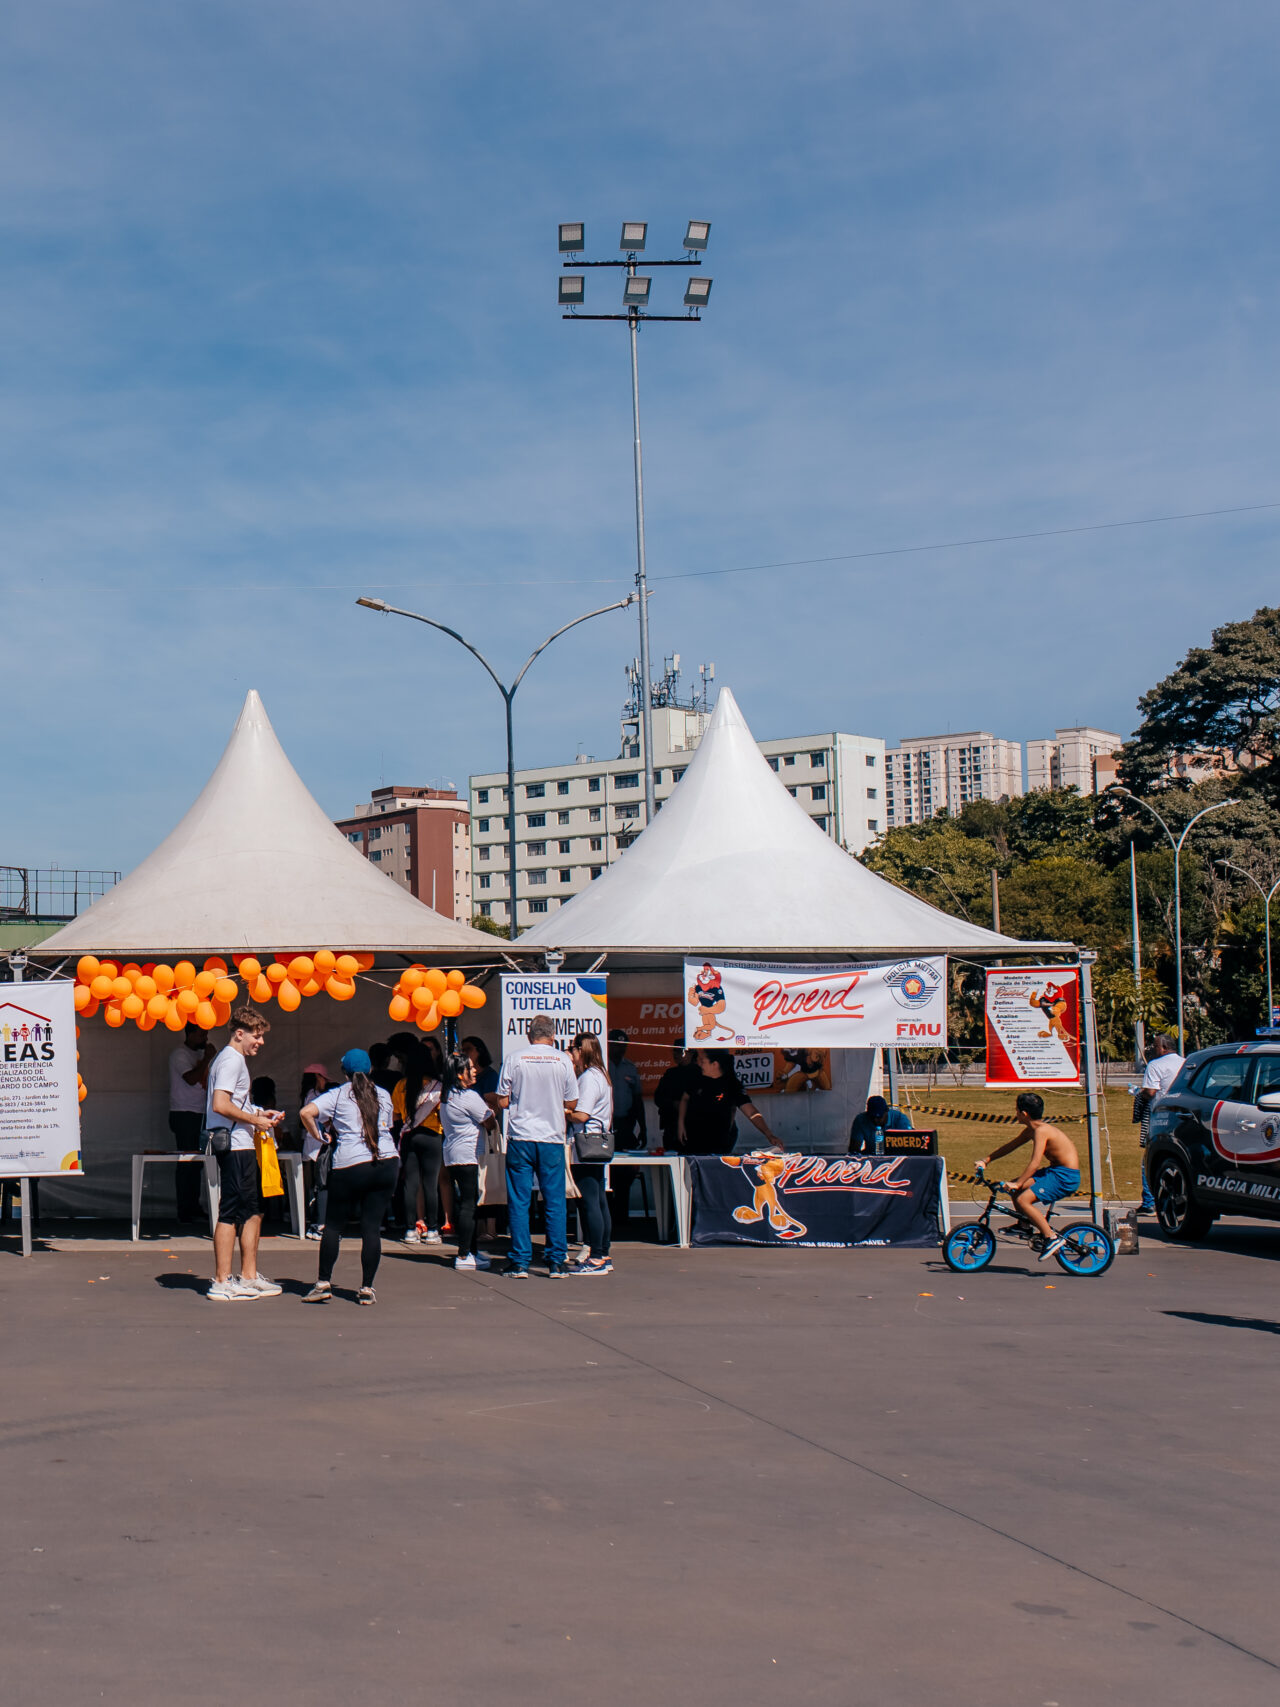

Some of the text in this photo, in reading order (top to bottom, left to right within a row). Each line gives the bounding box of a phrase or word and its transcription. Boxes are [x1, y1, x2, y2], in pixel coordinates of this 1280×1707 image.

[723, 961, 767, 969] Ensinando
[913, 961, 939, 981] MILITAR
[506, 981, 576, 995] CONSELHO
[510, 997, 572, 1010] TUTELAR
[753, 975, 864, 1025] Proerd
[639, 1003, 684, 1019] PRO
[507, 1017, 603, 1036] ATEIMENTO
[642, 1027, 665, 1035] uma
[669, 1025, 684, 1034] vid
[896, 1023, 941, 1036] FMU
[10, 1061, 53, 1069] REFERÊNCIA
[736, 1056, 770, 1069] ASTO
[885, 1136, 922, 1149] PROERD
[778, 1155, 911, 1188] Proerd
[1197, 1174, 1280, 1200] POLÍCIA MILI
